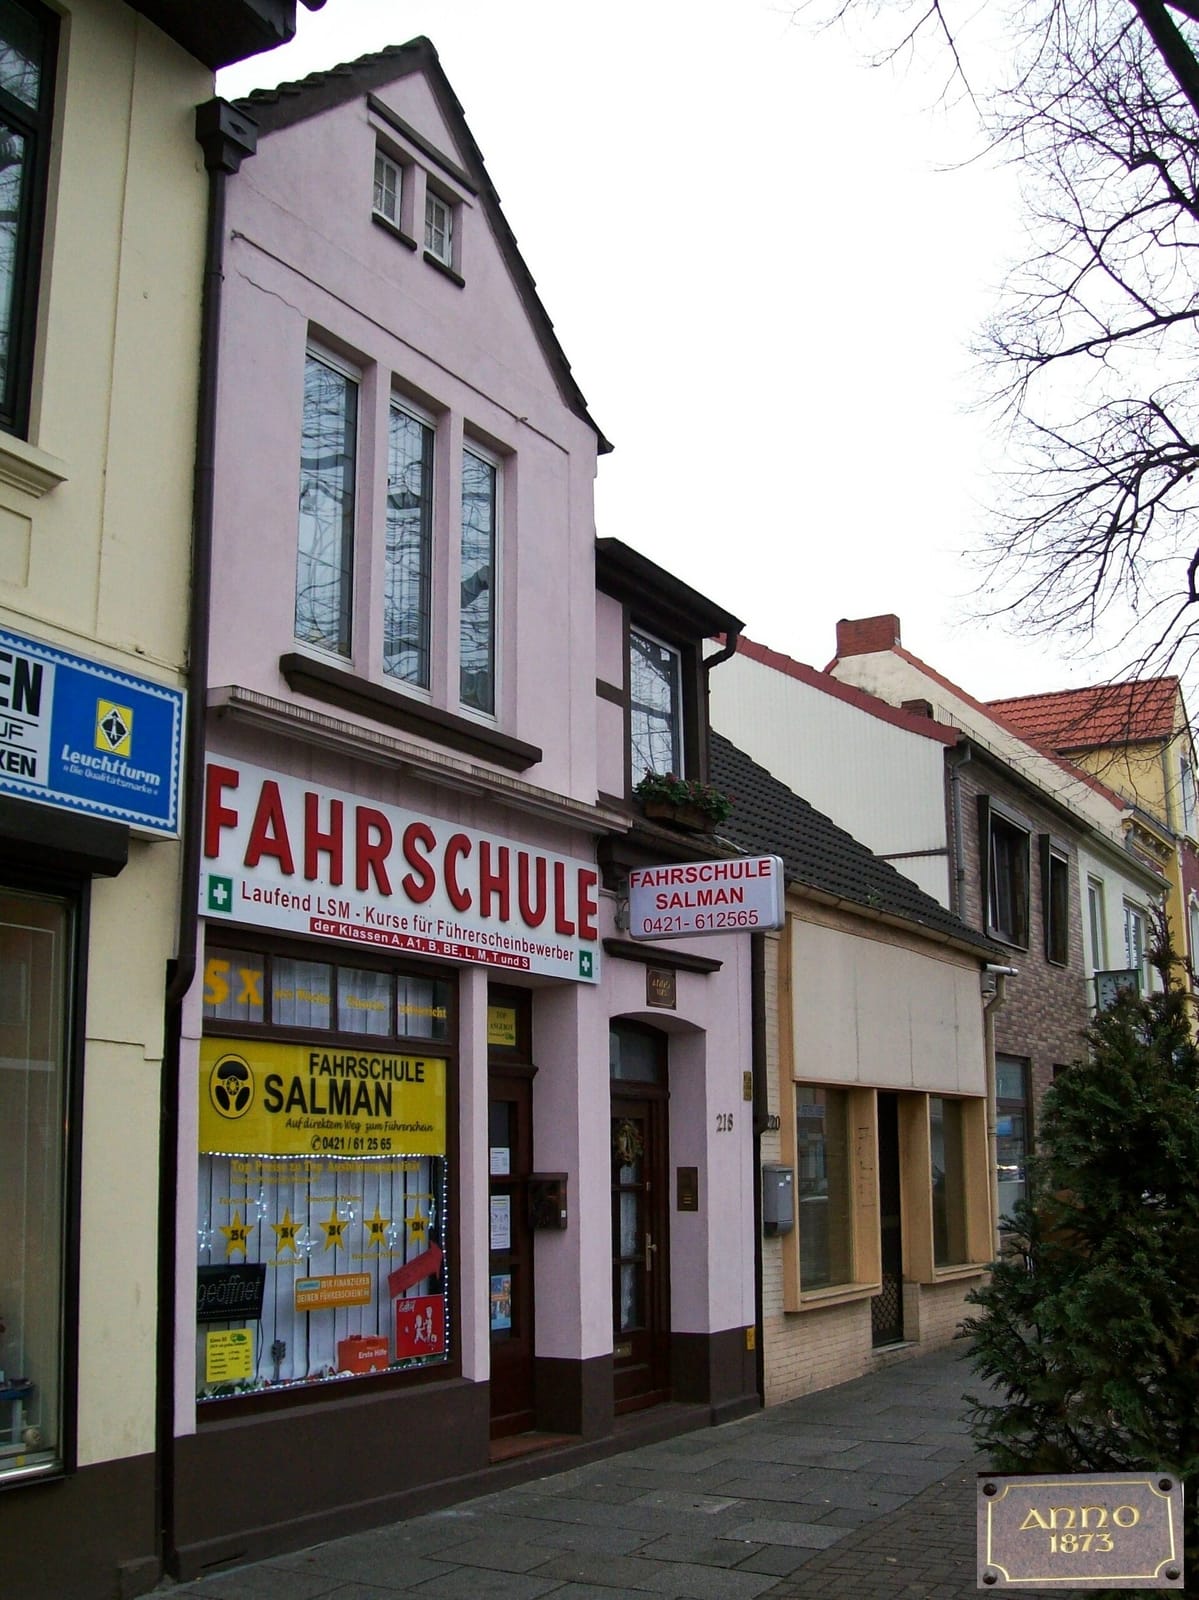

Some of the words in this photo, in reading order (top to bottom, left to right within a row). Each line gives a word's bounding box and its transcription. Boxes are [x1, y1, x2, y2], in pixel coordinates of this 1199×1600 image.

[61, 744, 161, 786] Leuchtturm
[204, 763, 597, 941] FAHRSCHULE
[630, 859, 771, 888] FAHRSCHULE
[655, 886, 744, 910] SALMAN
[242, 881, 310, 912] Laufend
[317, 896, 350, 919] LSM
[366, 906, 408, 930] Kurse
[413, 914, 433, 934] für
[437, 920, 574, 962] Führerscheinbewerber
[644, 915, 690, 933] 0421-
[695, 909, 758, 930] 612565
[314, 918, 335, 933] der
[339, 923, 388, 944] Klassen
[492, 952, 500, 963] T
[501, 954, 519, 967] und
[521, 957, 529, 968] S
[203, 959, 230, 1006] 5
[309, 1053, 424, 1083] FAHRSCHULE
[263, 1074, 393, 1117] SALMAN
[285, 1117, 304, 1132] Auf
[322, 1136, 345, 1150] 0421
[353, 1137, 364, 1150] 61
[367, 1137, 378, 1150] 25
[380, 1137, 392, 1151] 65
